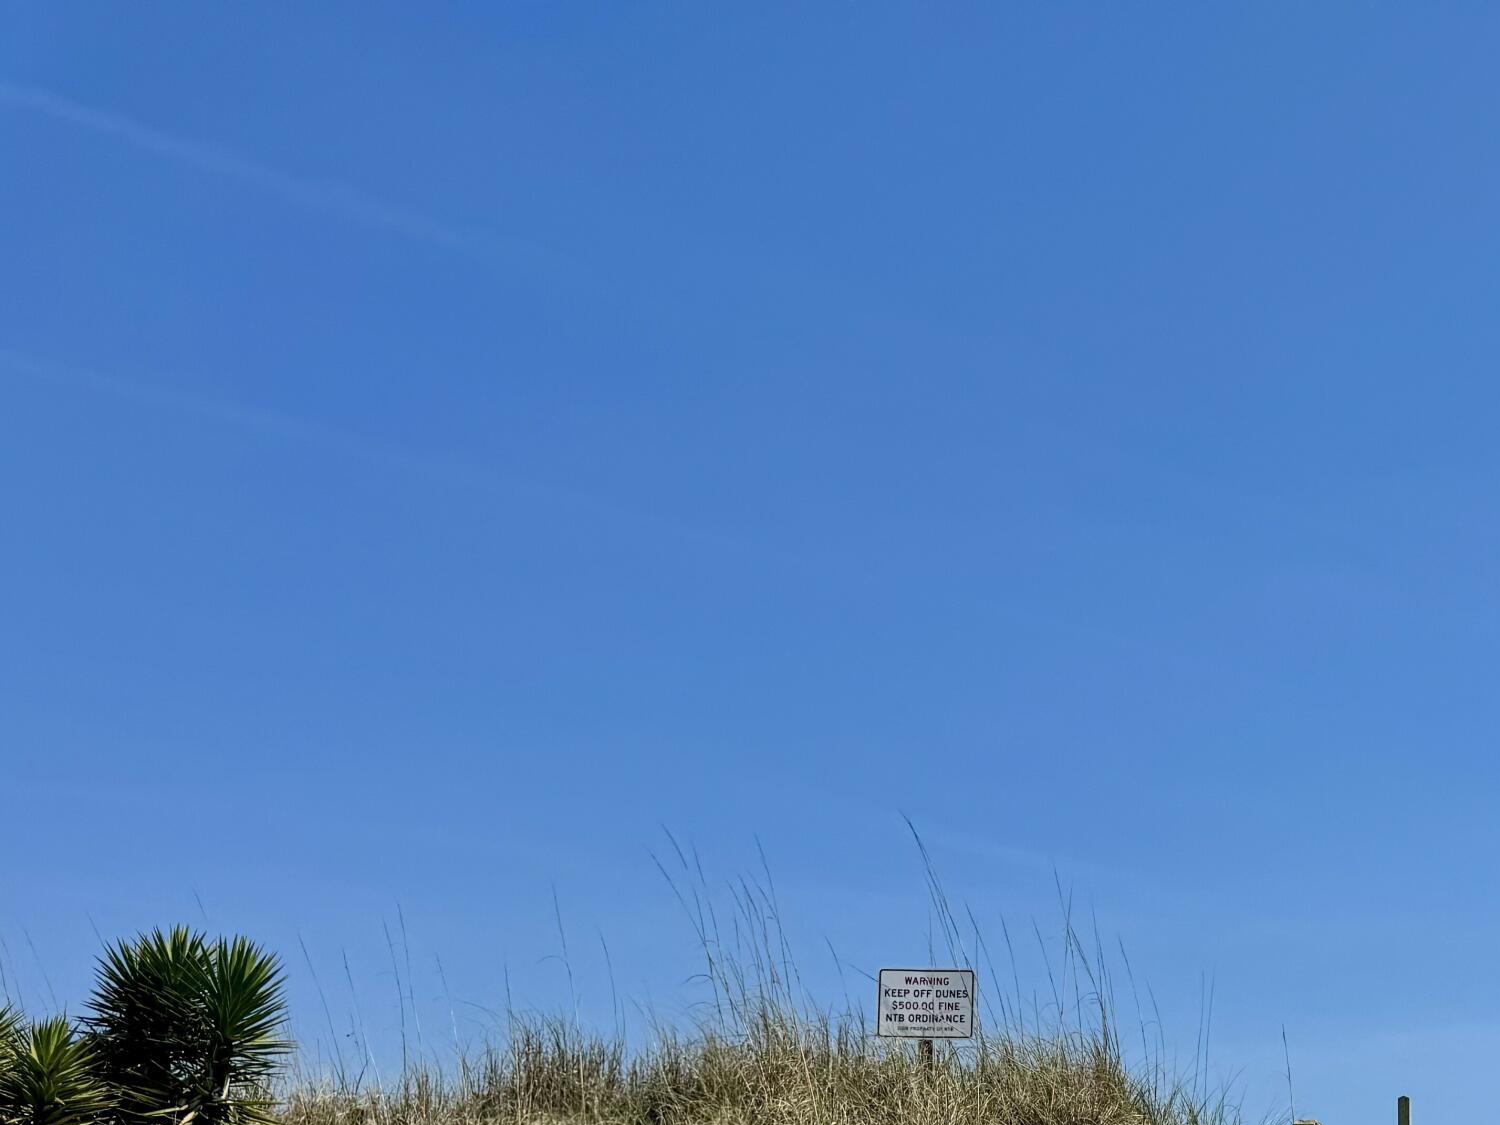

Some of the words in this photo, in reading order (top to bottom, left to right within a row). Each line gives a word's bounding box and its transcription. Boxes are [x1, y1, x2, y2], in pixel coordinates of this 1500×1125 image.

[904, 976, 950, 986] WARNING
[884, 989, 910, 997] KEEP
[913, 989, 932, 998] OFF
[936, 990, 968, 998] DUNES
[892, 1001, 934, 1010] $500.00
[938, 1002, 960, 1010] FINE
[885, 1014, 905, 1022] NTB
[908, 1014, 966, 1023] ORDINANCE
